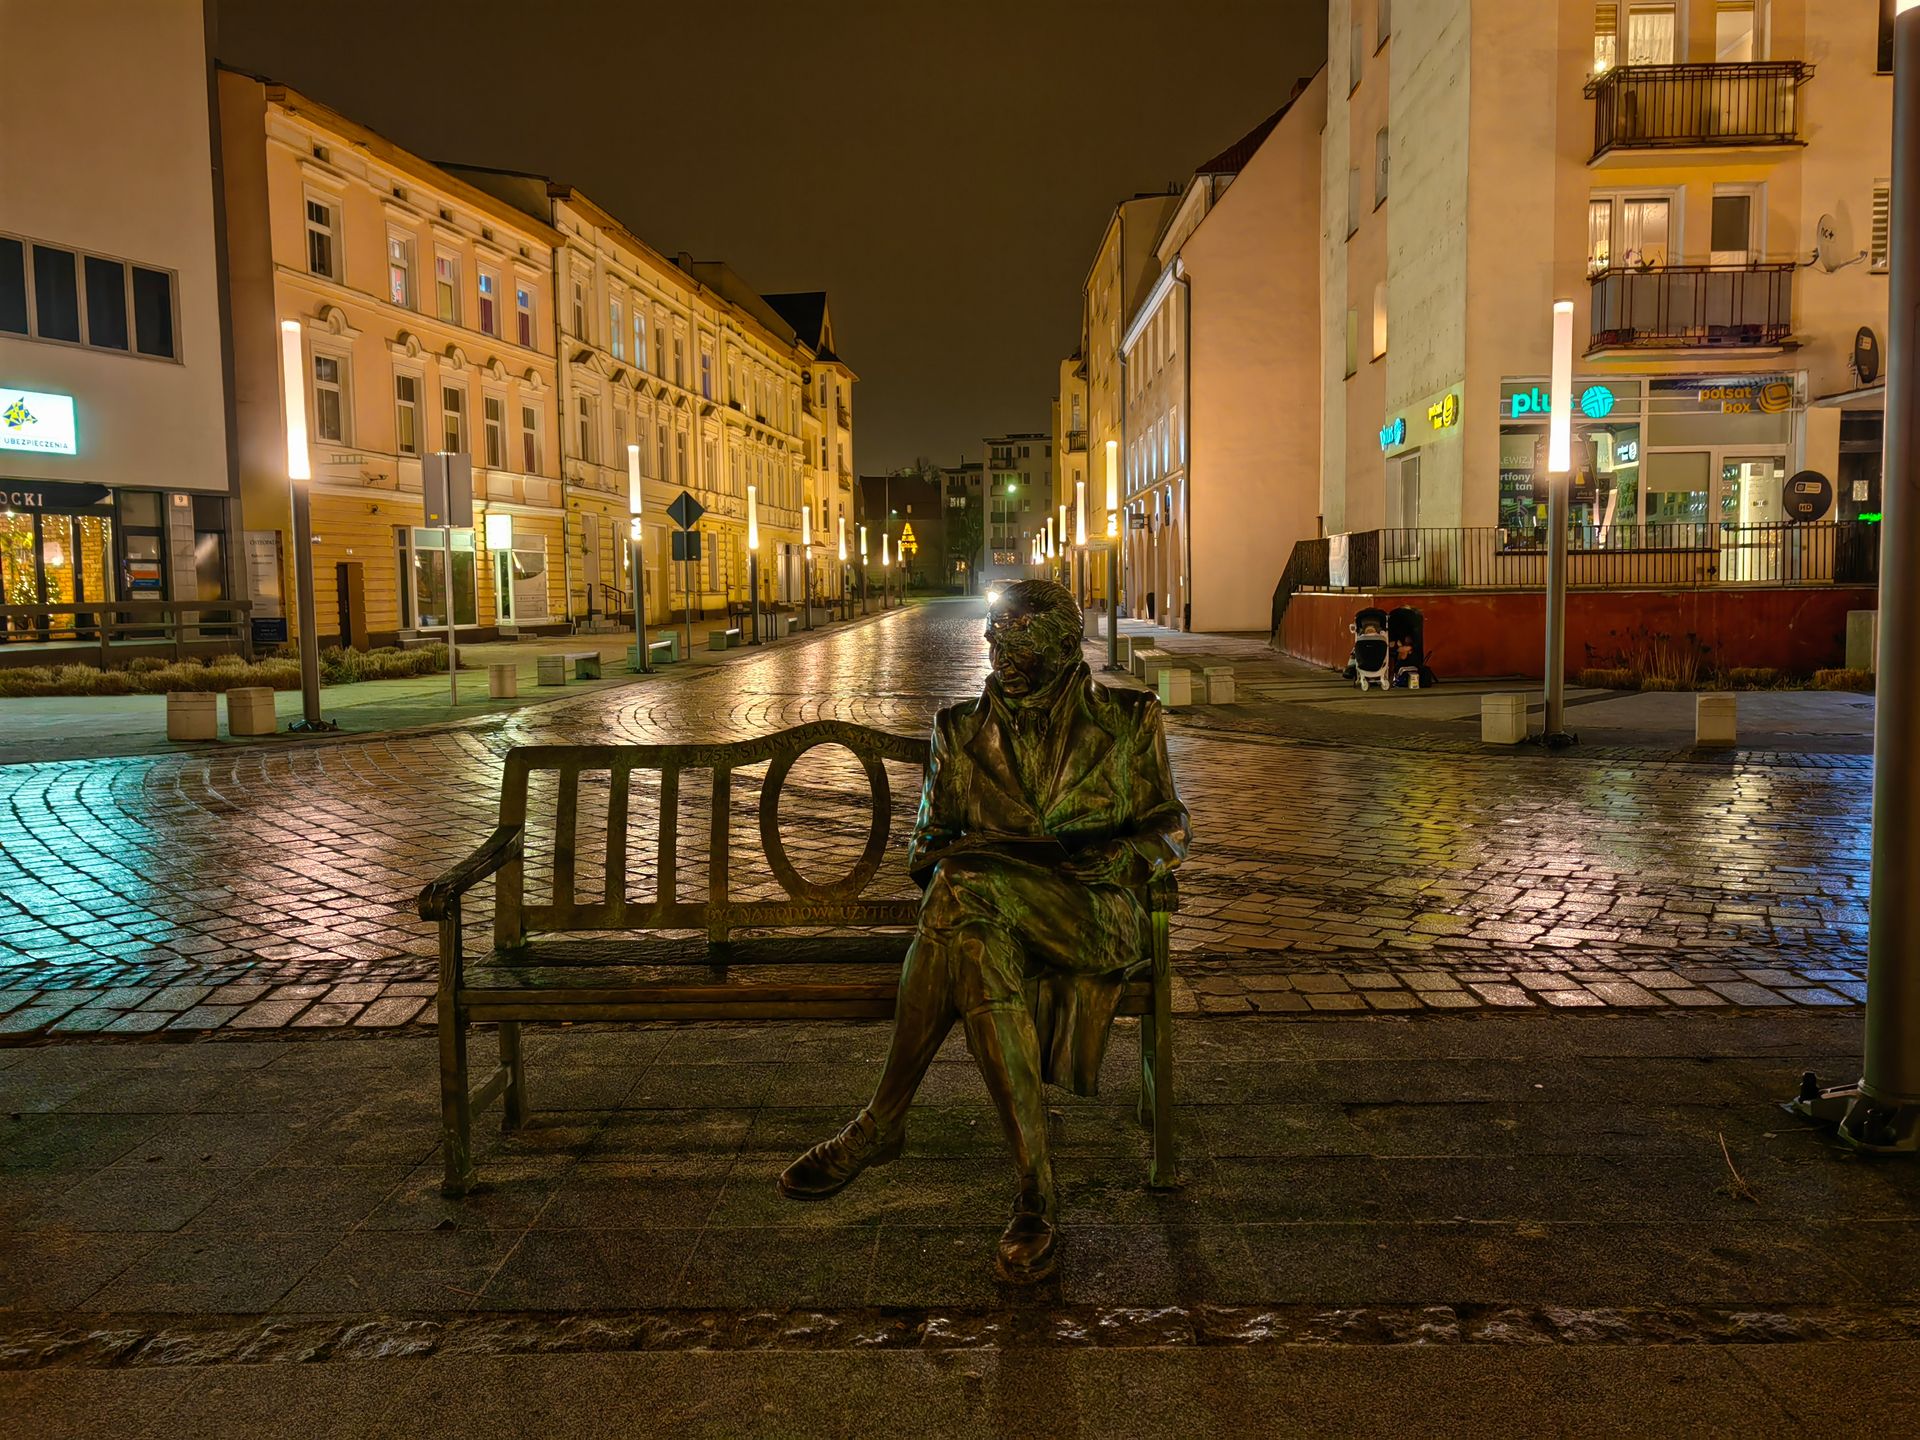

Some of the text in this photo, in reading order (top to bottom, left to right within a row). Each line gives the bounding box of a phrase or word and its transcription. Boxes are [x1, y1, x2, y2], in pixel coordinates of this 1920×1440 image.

[1698, 387, 1751, 402] polsat
[1511, 387, 1576, 418] plu
[1721, 401, 1751, 414] box
[3, 437, 69, 449] UBEZPIECZENIA
[1800, 504, 1812, 512] HD
